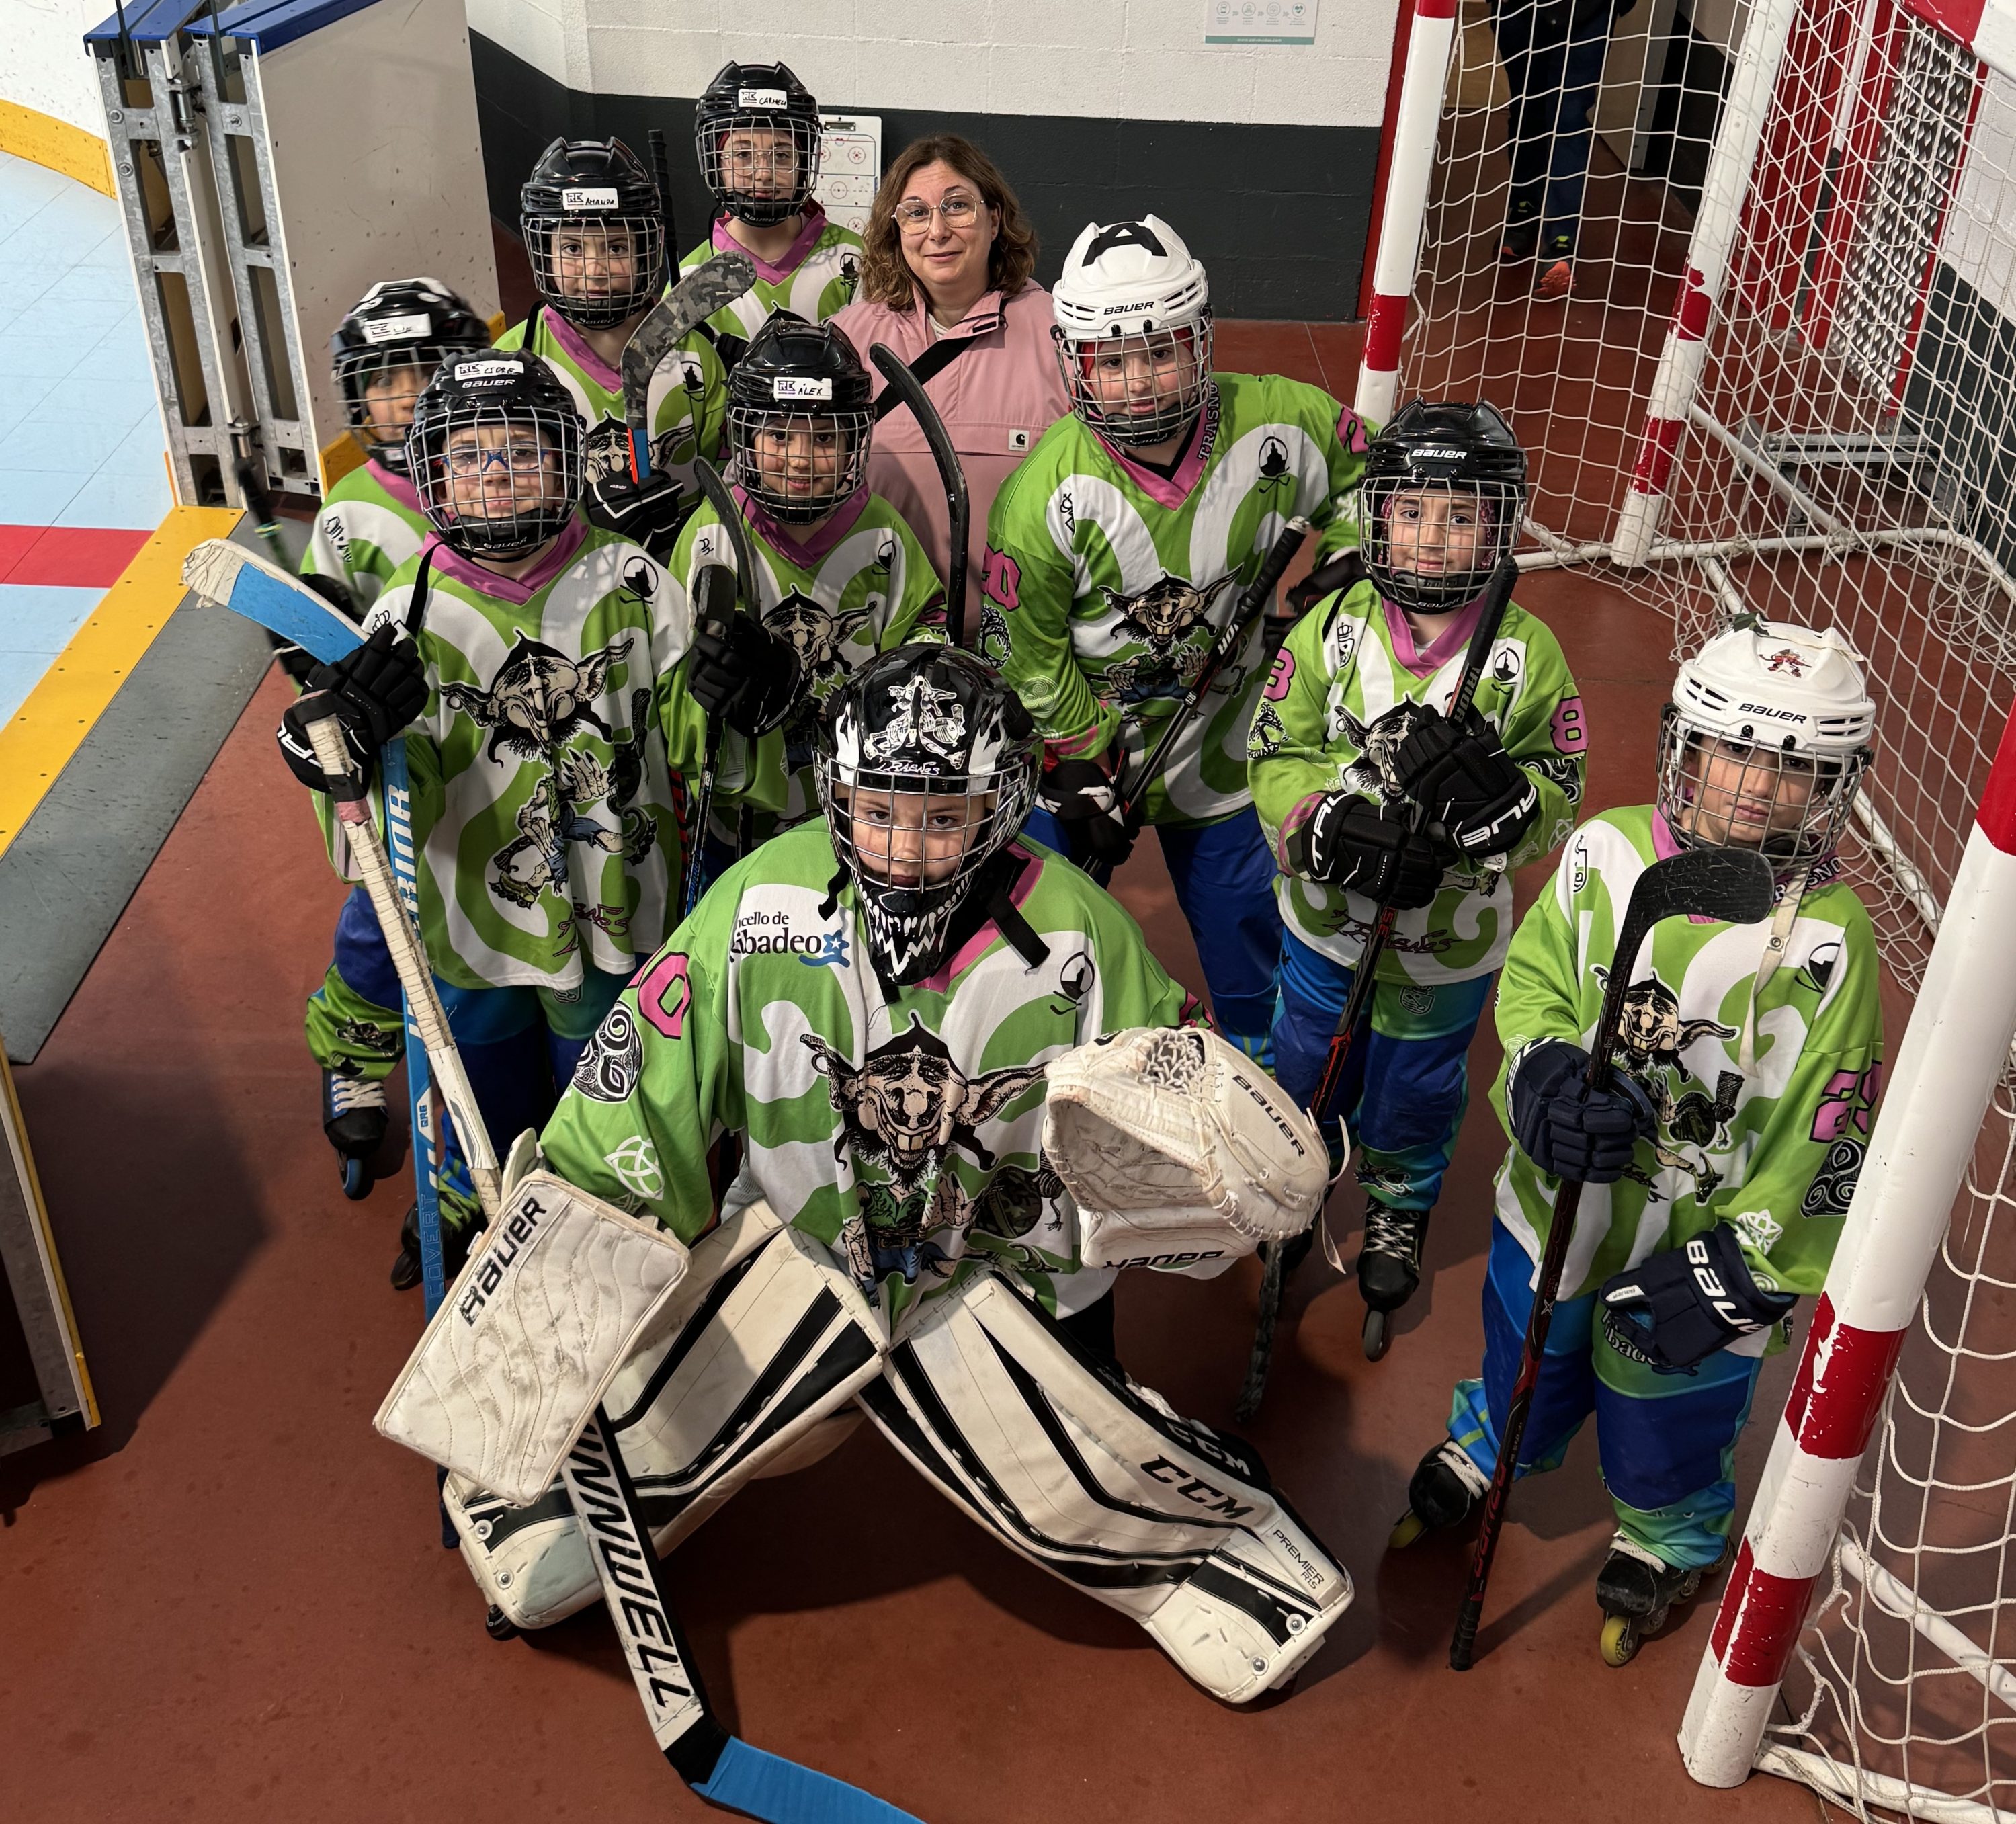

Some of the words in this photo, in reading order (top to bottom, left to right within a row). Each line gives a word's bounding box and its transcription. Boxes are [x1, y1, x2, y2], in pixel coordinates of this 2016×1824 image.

[1550, 696, 1590, 756] 8
[730, 927, 822, 963] ibadeo
[772, 911, 790, 925] de
[625, 942, 693, 1040] 0
[421, 1194, 445, 1298] COVERT
[1141, 1454, 1255, 1520] CCM
[571, 1424, 691, 1708] INNWELL
[1273, 1529, 1325, 1585] PREMIER
